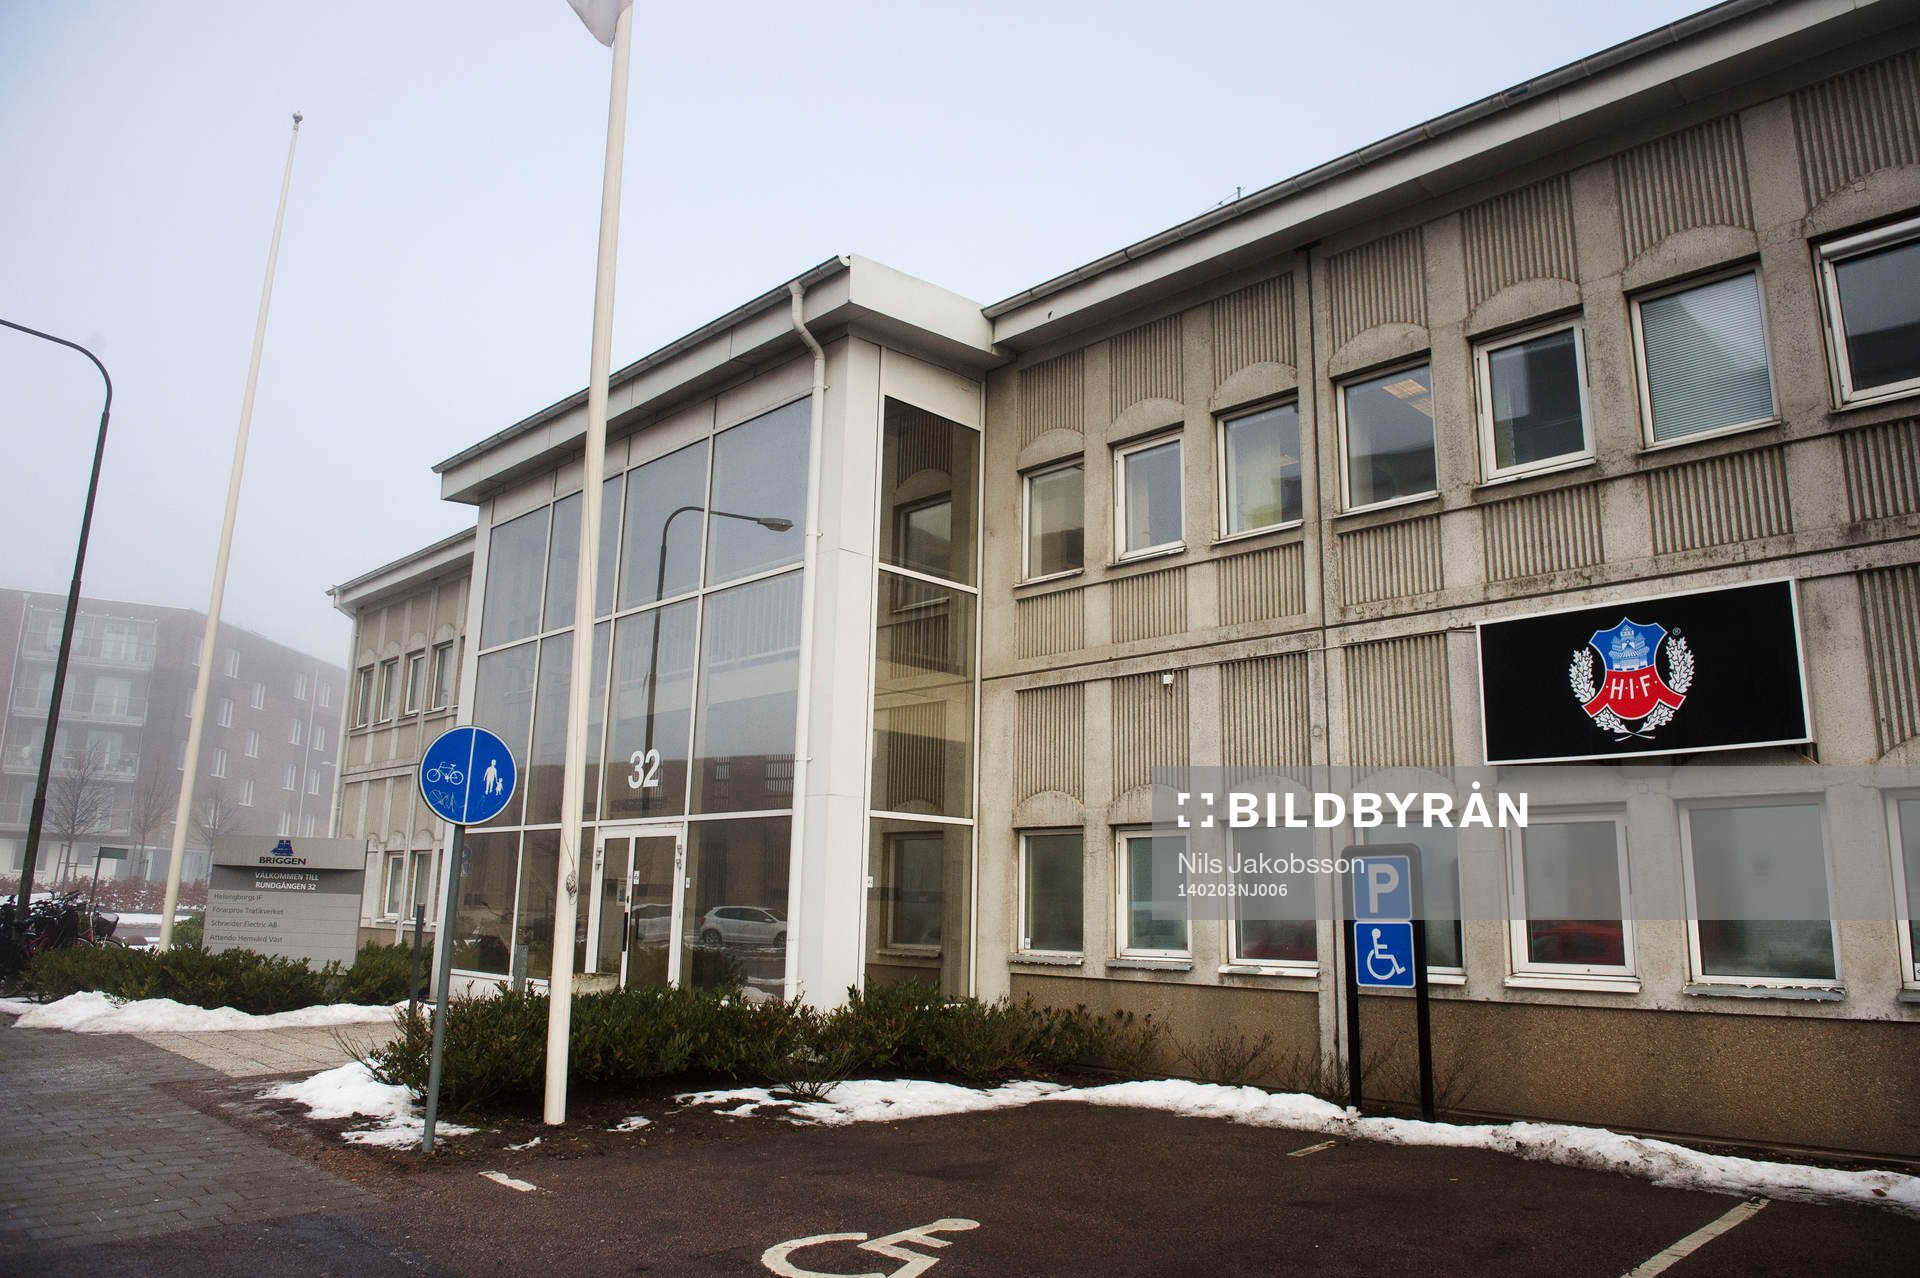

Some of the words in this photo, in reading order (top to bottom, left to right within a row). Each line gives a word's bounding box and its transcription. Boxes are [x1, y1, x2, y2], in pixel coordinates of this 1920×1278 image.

[628, 749, 661, 789] 32
[259, 856, 306, 865] BRIGGEN
[305, 873, 319, 881] TILL
[255, 881, 306, 890] RUNDGÅNGEN
[307, 883, 317, 891] 32
[1368, 863, 1400, 914] P
[244, 920, 267, 928] Electric
